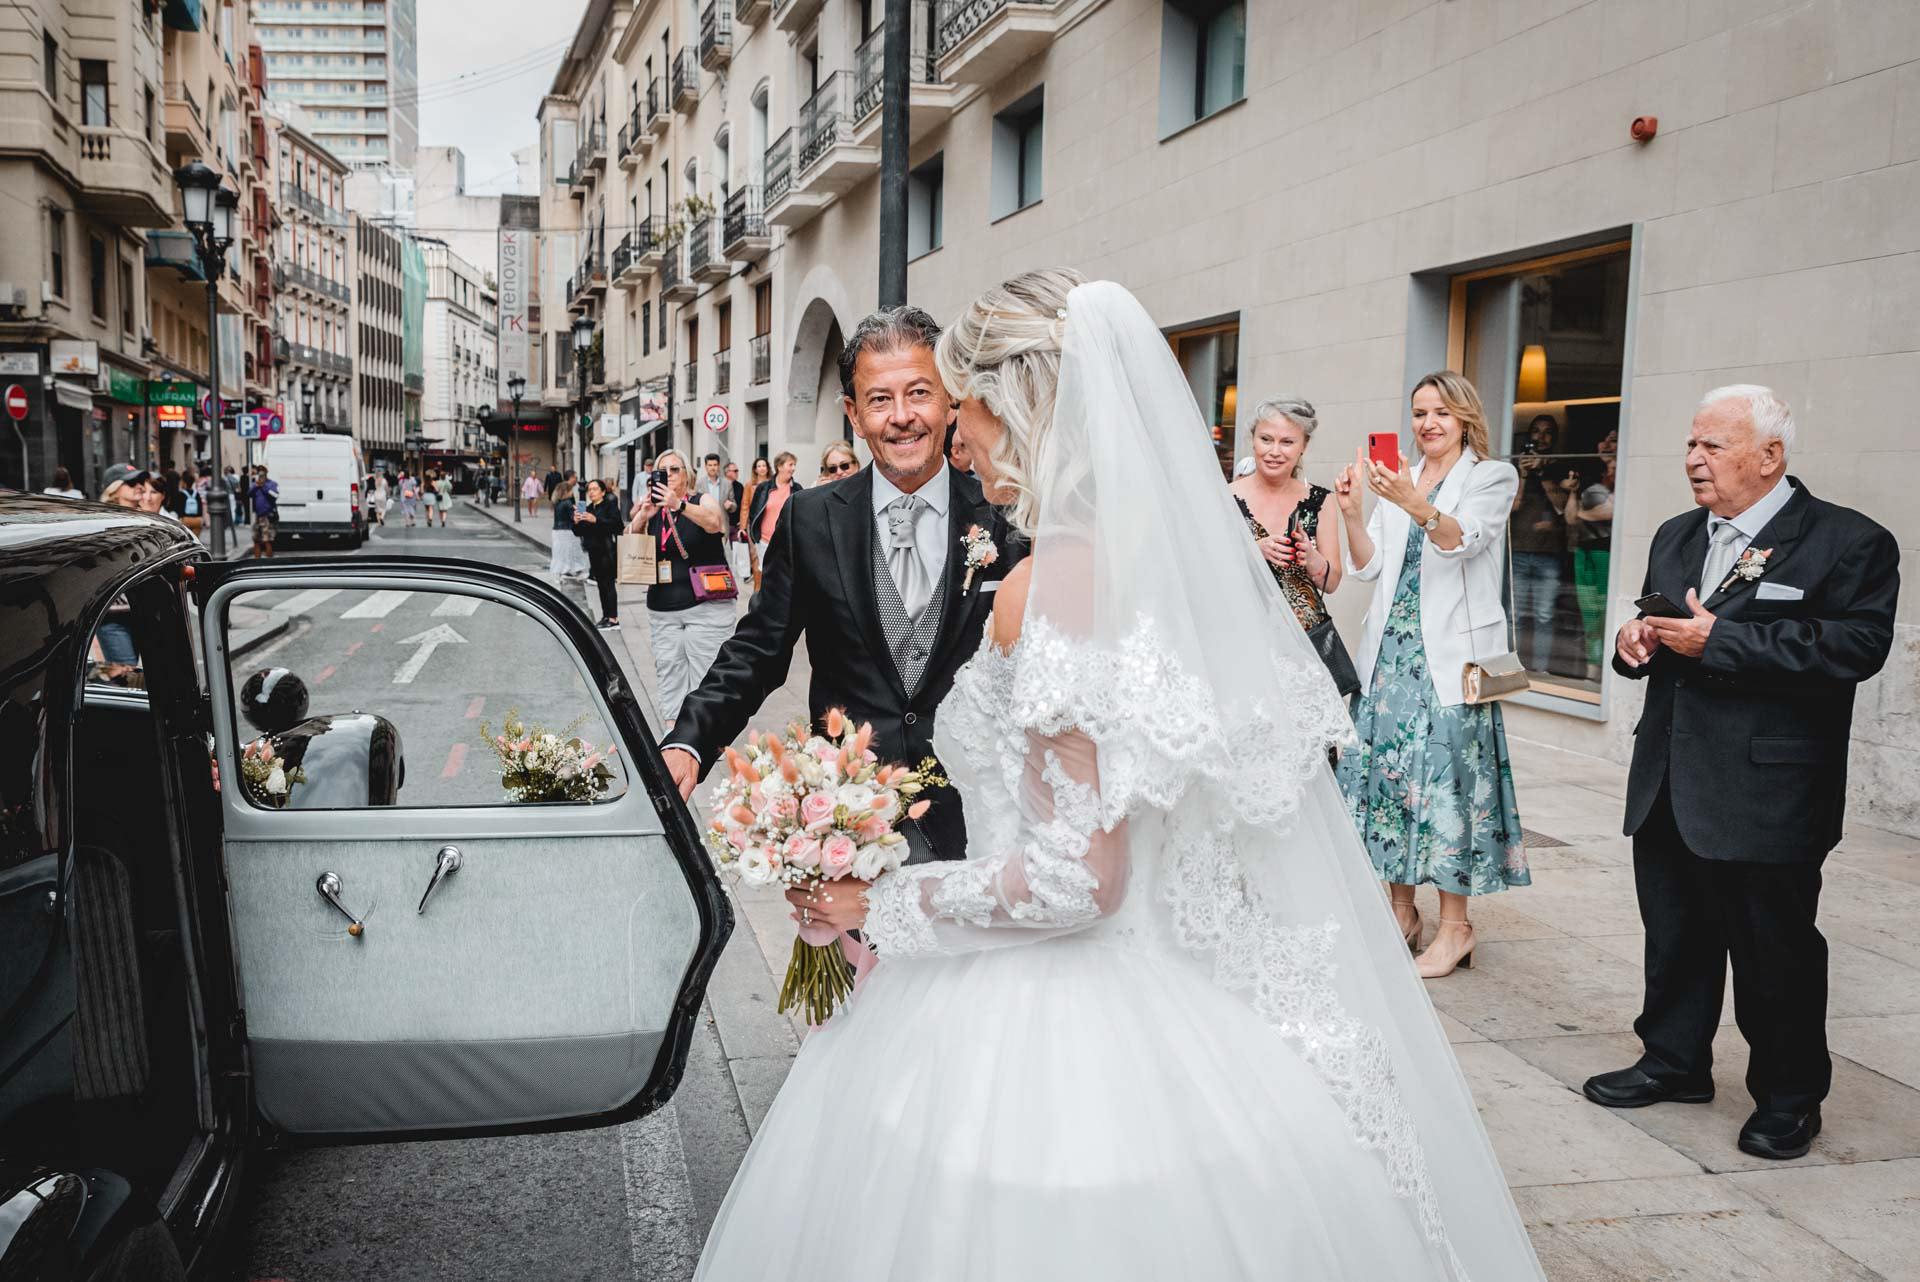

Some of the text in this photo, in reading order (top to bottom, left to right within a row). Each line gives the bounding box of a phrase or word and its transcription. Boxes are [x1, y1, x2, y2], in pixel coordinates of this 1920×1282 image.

[149, 391, 196, 402] LUFRAN
[709, 413, 724, 423] 20
[241, 416, 255, 435] P
